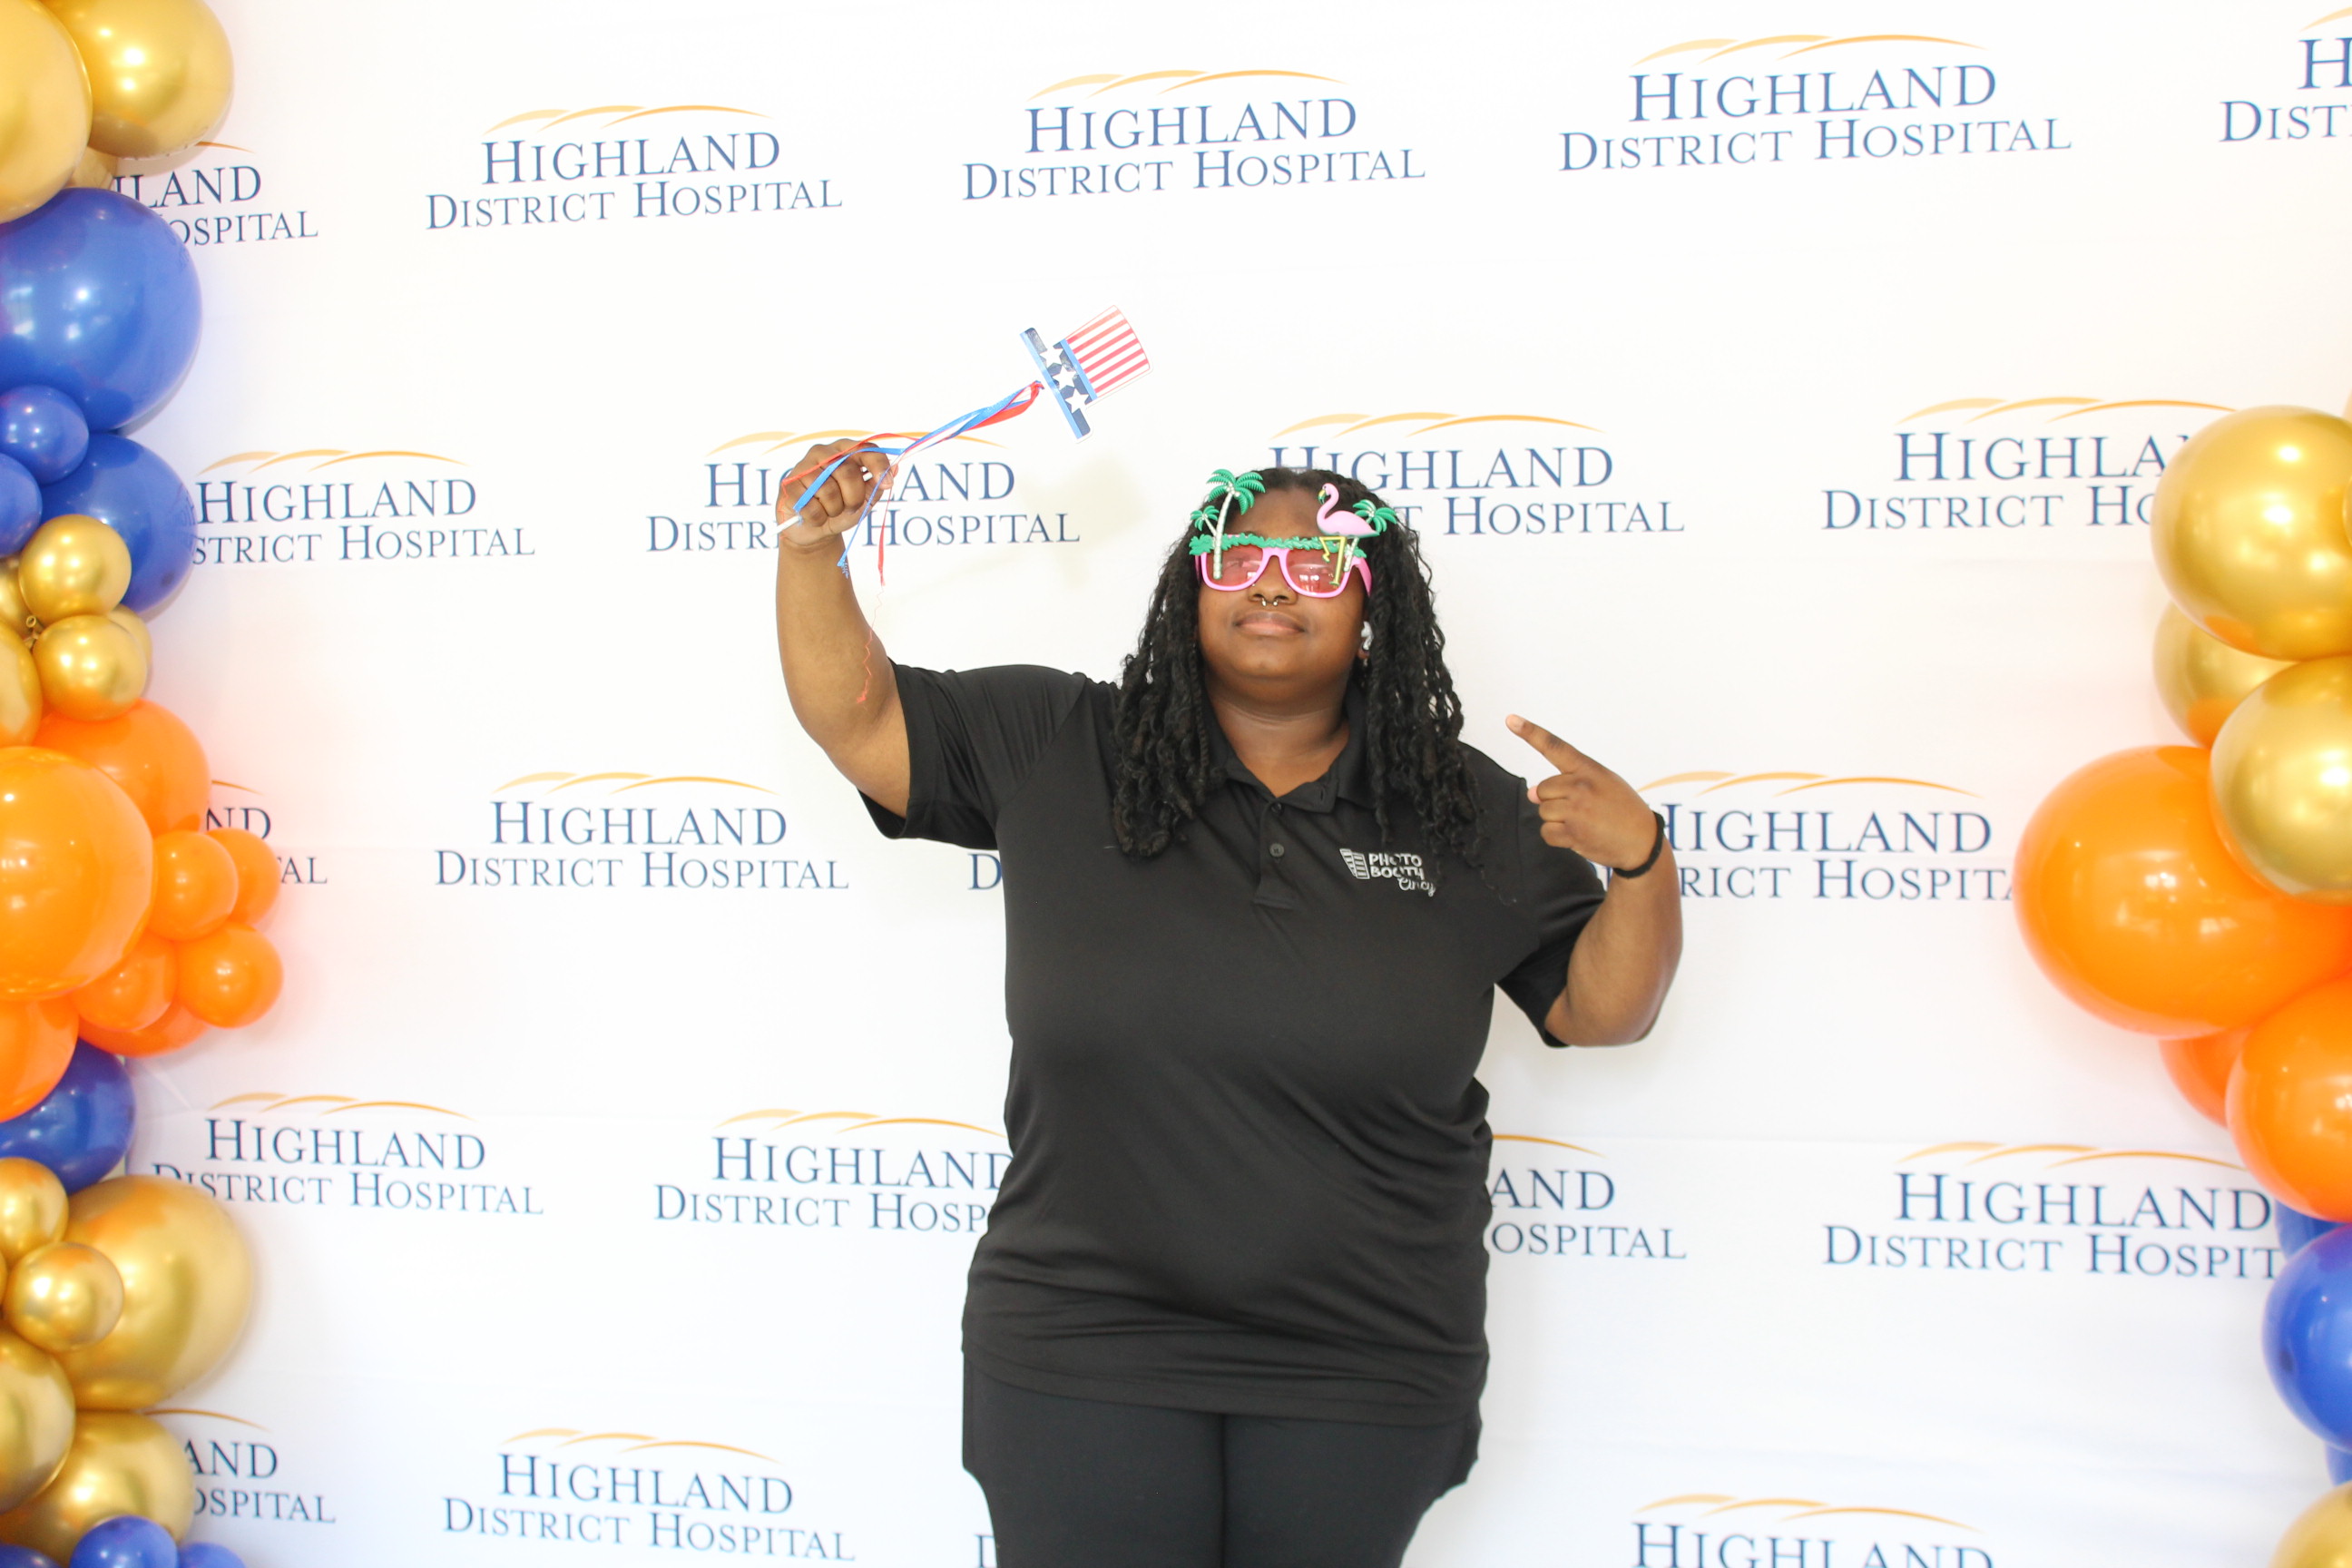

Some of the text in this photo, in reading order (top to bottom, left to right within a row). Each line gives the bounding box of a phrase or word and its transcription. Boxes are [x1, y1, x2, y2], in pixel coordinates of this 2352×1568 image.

[1629, 64, 1997, 122] HIGHLAND
[1024, 98, 1357, 153] HIGHLAND
[2219, 99, 2352, 142] DIST
[480, 132, 780, 185] HIGHLAND
[1558, 118, 2073, 172] DISTRICT HOSPITAL
[113, 164, 261, 210] LAND
[962, 148, 1426, 201] DISTRICT HOSPITAL
[425, 179, 845, 230] DISTRICT HOSPITAL
[168, 210, 318, 246] OSPITAL
[1894, 431, 2190, 482] HIGHLA
[194, 479, 476, 524] HIGHLAND
[703, 461, 1015, 508] HIAND
[646, 509, 1081, 552] DISTR HOSPITAL
[1443, 495, 1685, 535] HOSPITAL
[1821, 489, 2064, 530] DISTRICT
[192, 524, 535, 565] STRICT HOSPITAL
[489, 800, 788, 846] HIGHLAND
[436, 850, 849, 889] DISTRICT HOSPITAL
[1813, 858, 2013, 901] HOSPIT
[204, 1118, 485, 1171] HIGHLAND
[348, 1171, 544, 1215] HOSPITAL
[653, 1184, 987, 1233] DISTRICT HOSP
[1895, 1172, 2273, 1231] HIGHLAND
[1491, 1222, 1688, 1259] OSPITAL
[1822, 1225, 2282, 1280] DISTRICT HOSPIT
[193, 1487, 337, 1524] SPITAL
[497, 1453, 794, 1515] HIGHLAND
[442, 1497, 856, 1562] DISTRICT HOSPITAL
[1632, 1522, 1994, 1568] HIGHLAND
